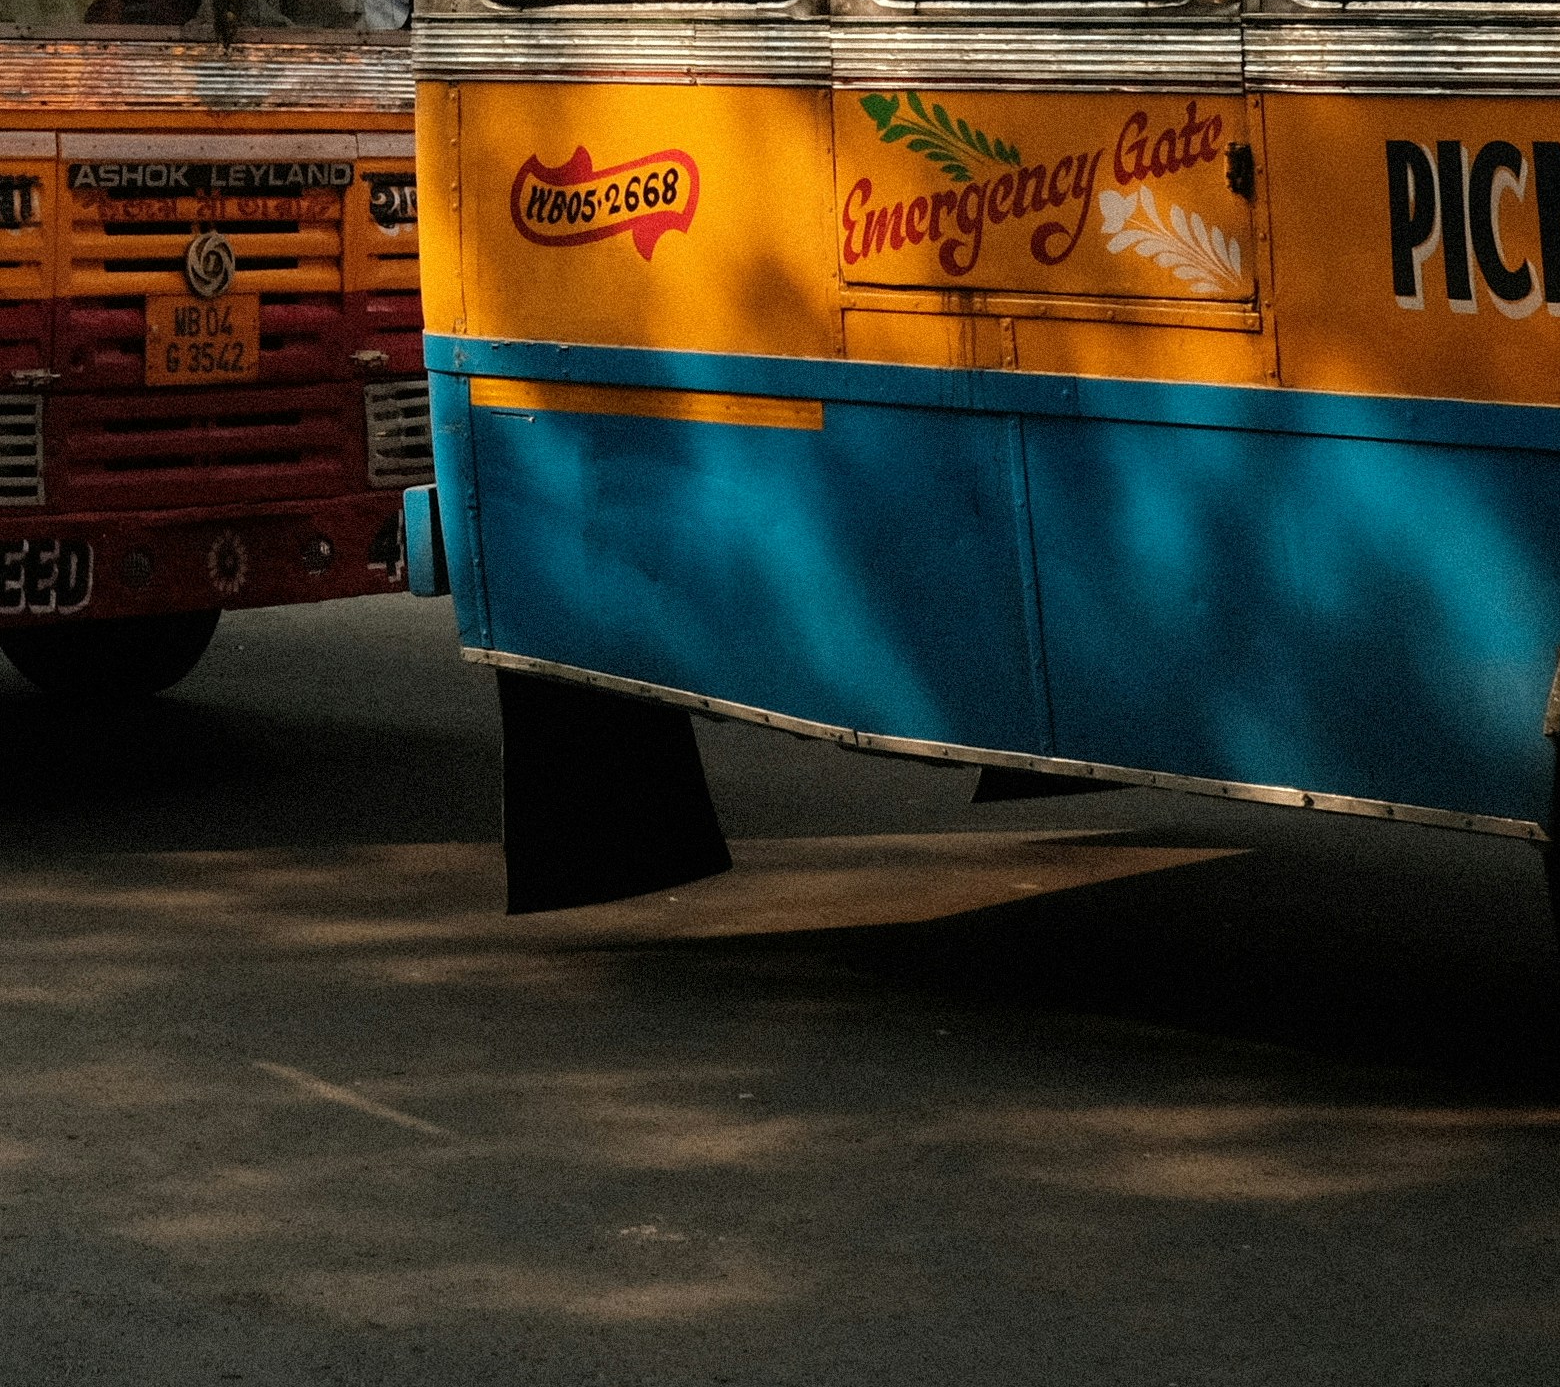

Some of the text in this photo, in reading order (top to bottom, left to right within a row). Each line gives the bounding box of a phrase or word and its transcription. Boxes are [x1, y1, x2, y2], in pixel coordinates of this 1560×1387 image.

[74, 163, 354, 188] ASHOK LEYLAND
[841, 100, 1224, 278] Emergency Gate
[175, 305, 233, 337] WB 04
[188, 341, 245, 373] 3542
